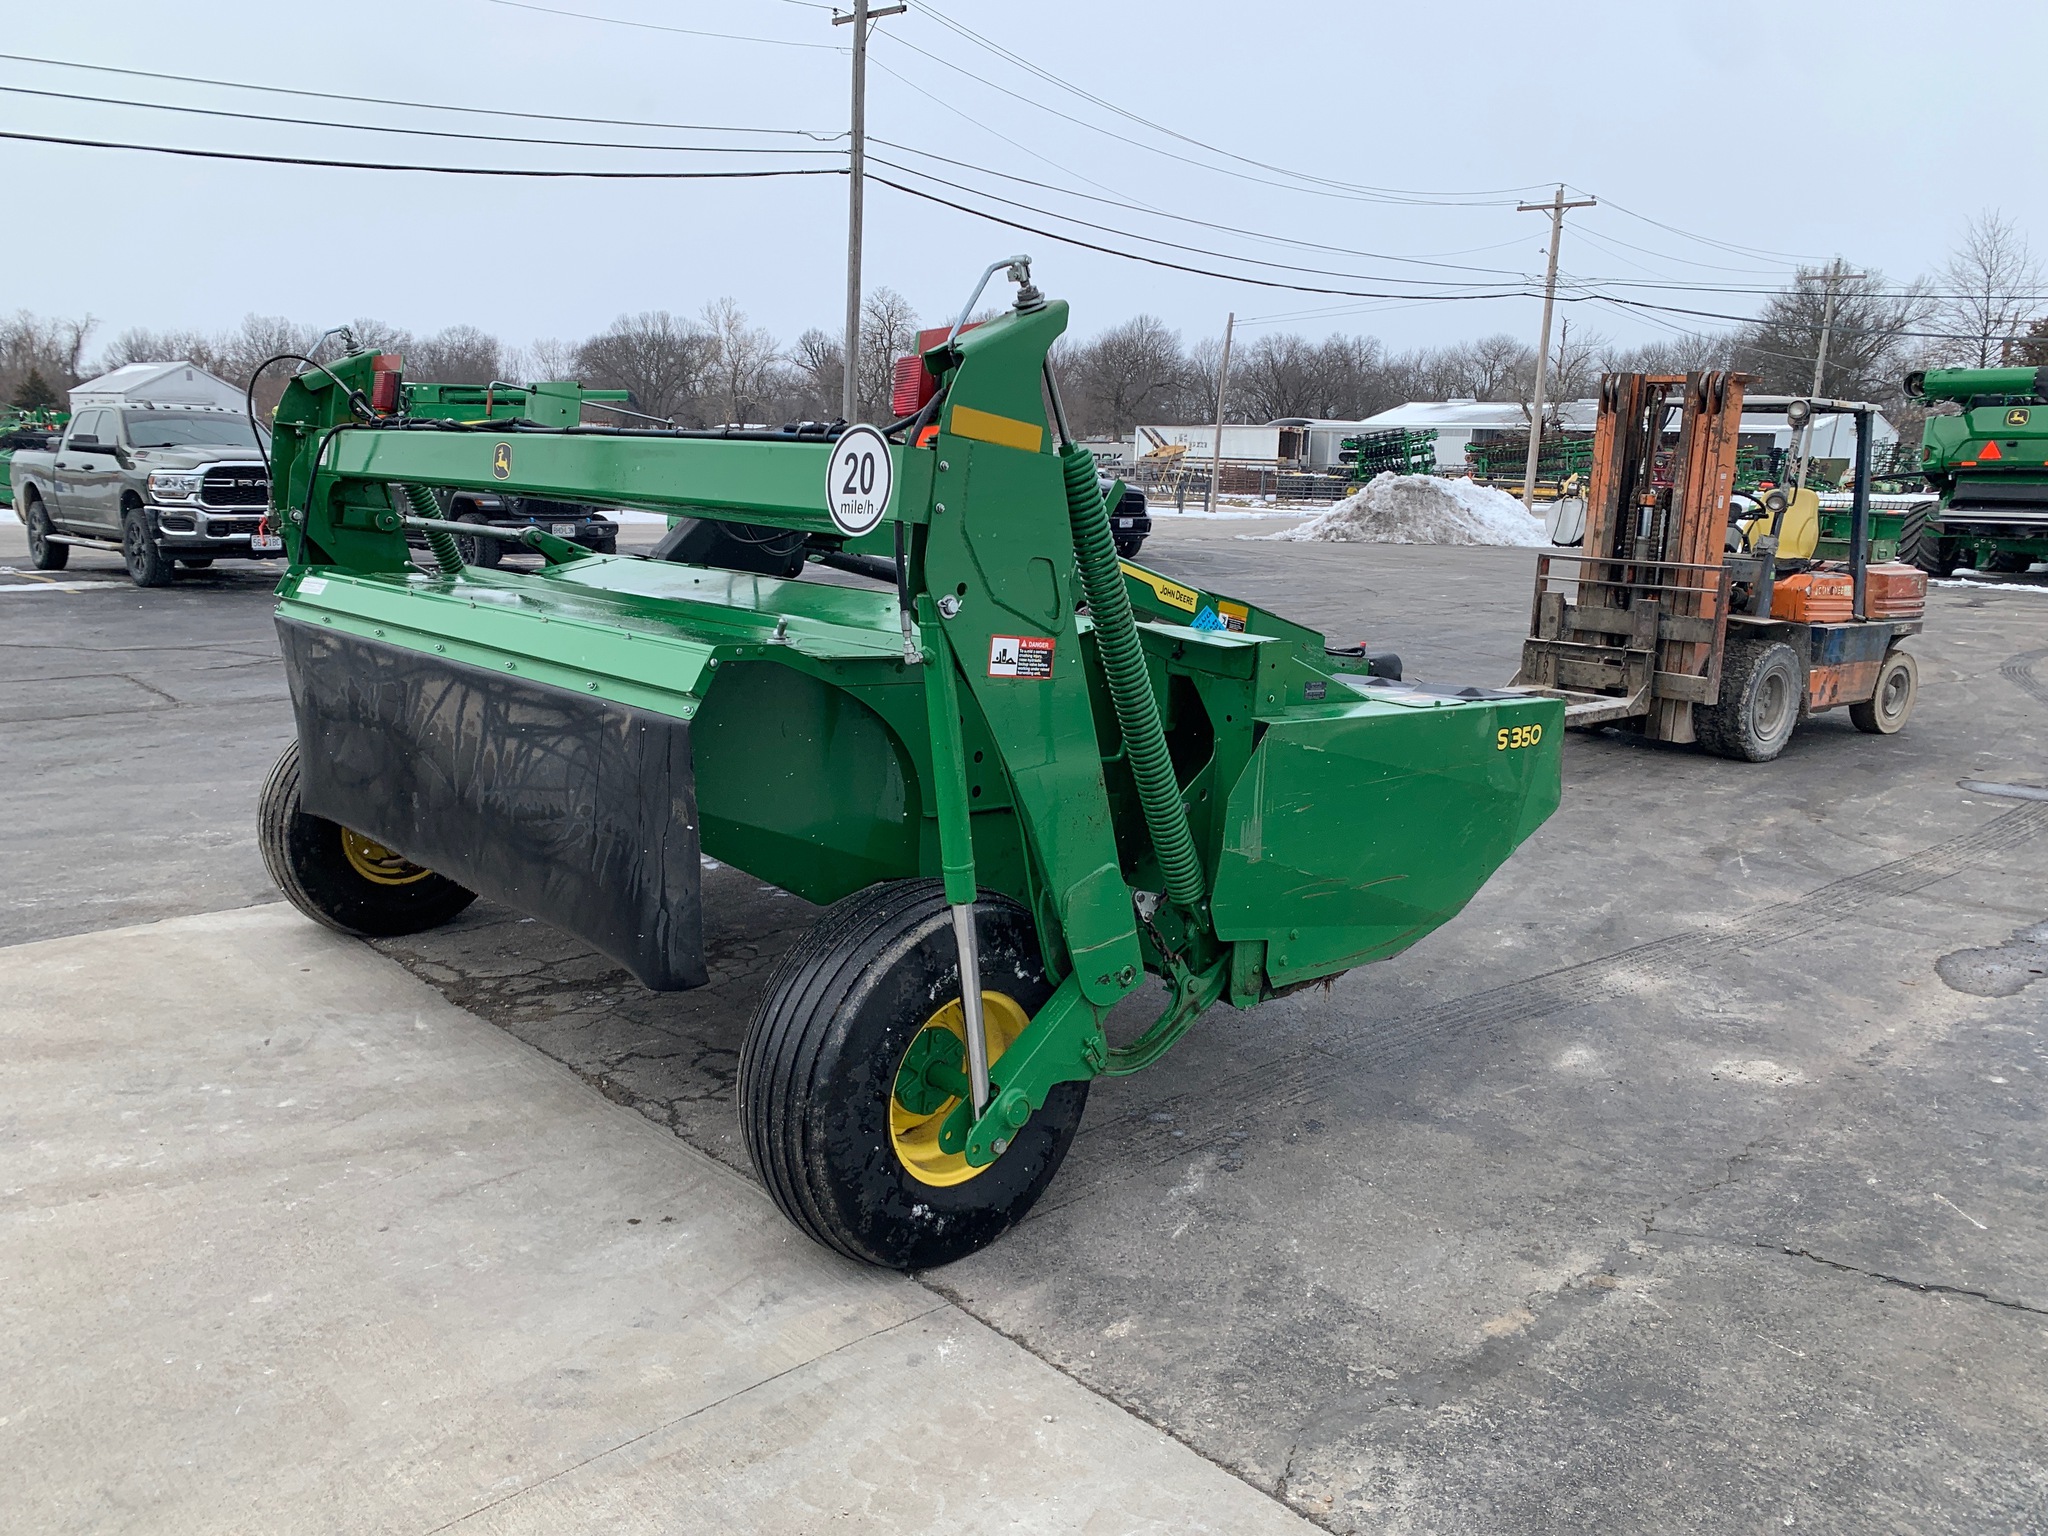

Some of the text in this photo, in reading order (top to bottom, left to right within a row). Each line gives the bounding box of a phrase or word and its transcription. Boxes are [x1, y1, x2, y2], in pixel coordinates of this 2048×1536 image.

[842, 451, 875, 495] 20
[840, 500, 874, 514] mile/h
[1159, 584, 1194, 606] JOHN DEERE
[1028, 641, 1049, 649] DANGER
[1496, 723, 1542, 751] S350
